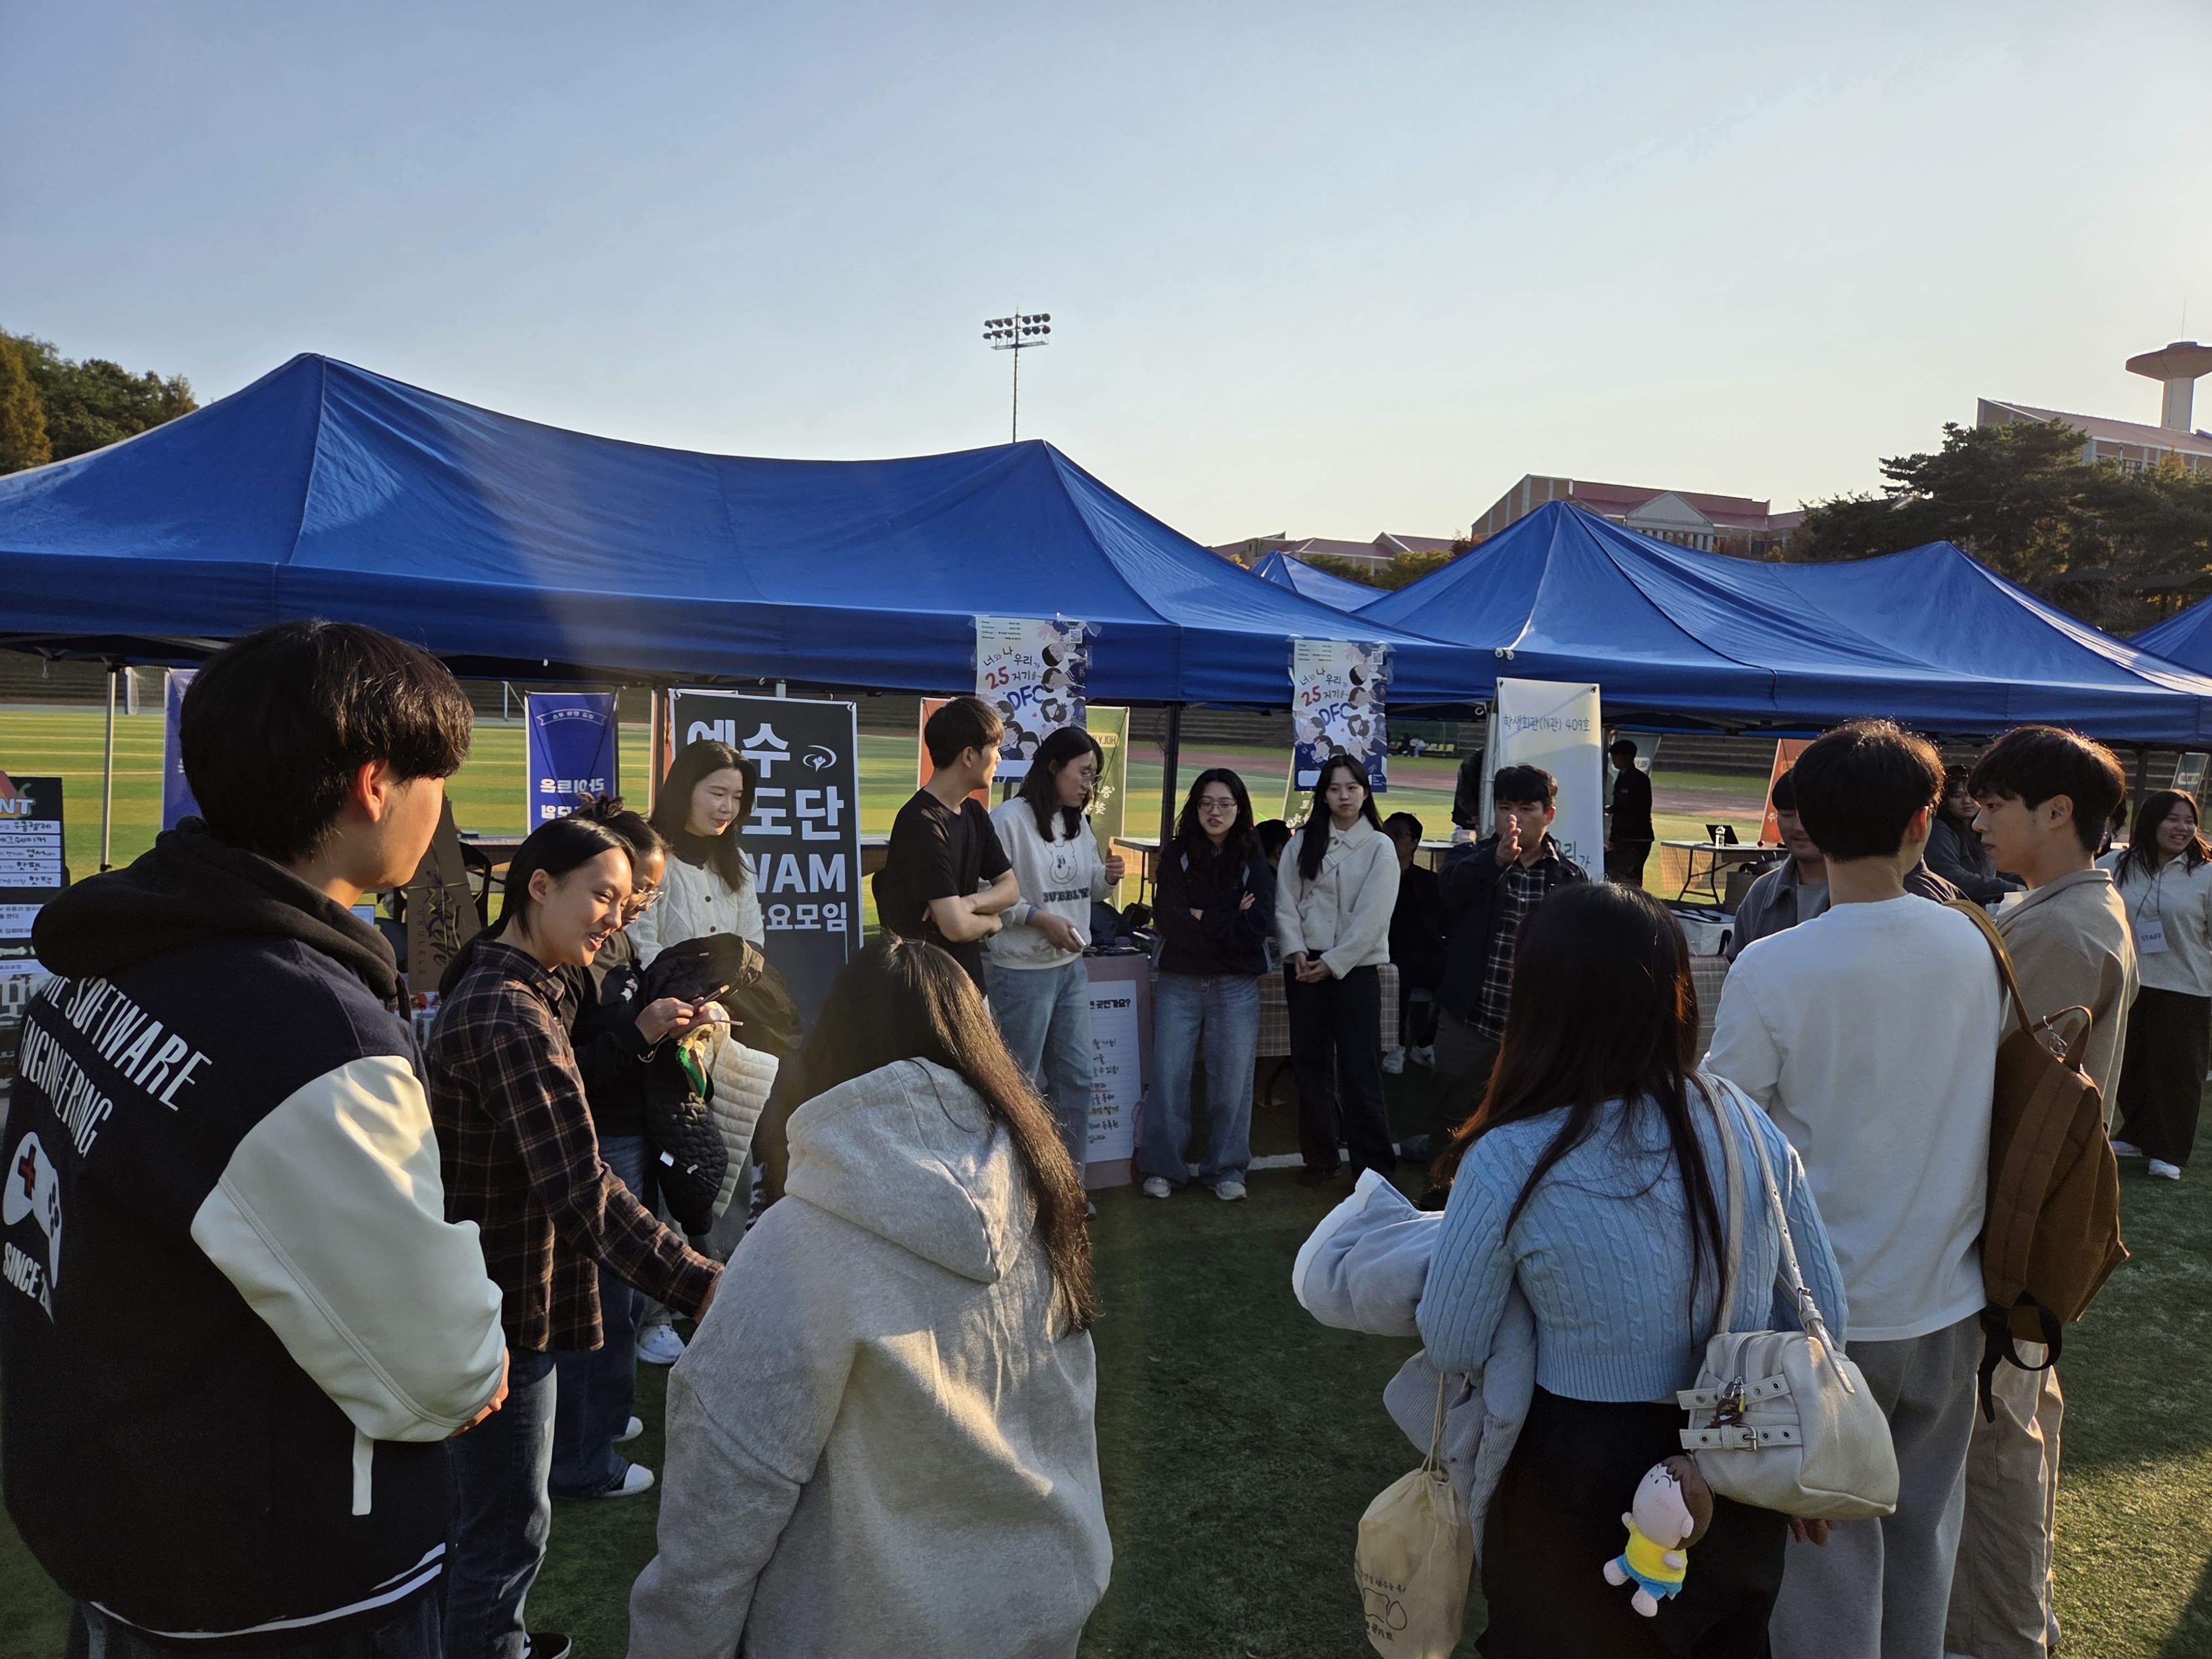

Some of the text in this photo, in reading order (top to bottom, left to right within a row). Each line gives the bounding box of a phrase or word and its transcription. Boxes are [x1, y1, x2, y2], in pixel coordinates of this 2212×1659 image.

[983, 646, 1040, 669] 너와 나 우리가
[985, 666, 1009, 690] 25
[1316, 667, 1326, 676] 나
[1006, 685, 1044, 711] DFC
[1301, 685, 1321, 707] 25
[1318, 702, 1349, 726] DFC
[1503, 714, 1590, 732] 학생회관(N관) 409호
[741, 786, 844, 840] 도단
[747, 853, 846, 894] AM
[761, 902, 847, 932] 요모임
[65, 977, 213, 1112] SOFTWARE
[18, 1014, 113, 1159] ENGINEERING
[3, 1241, 41, 1299] SINCE
